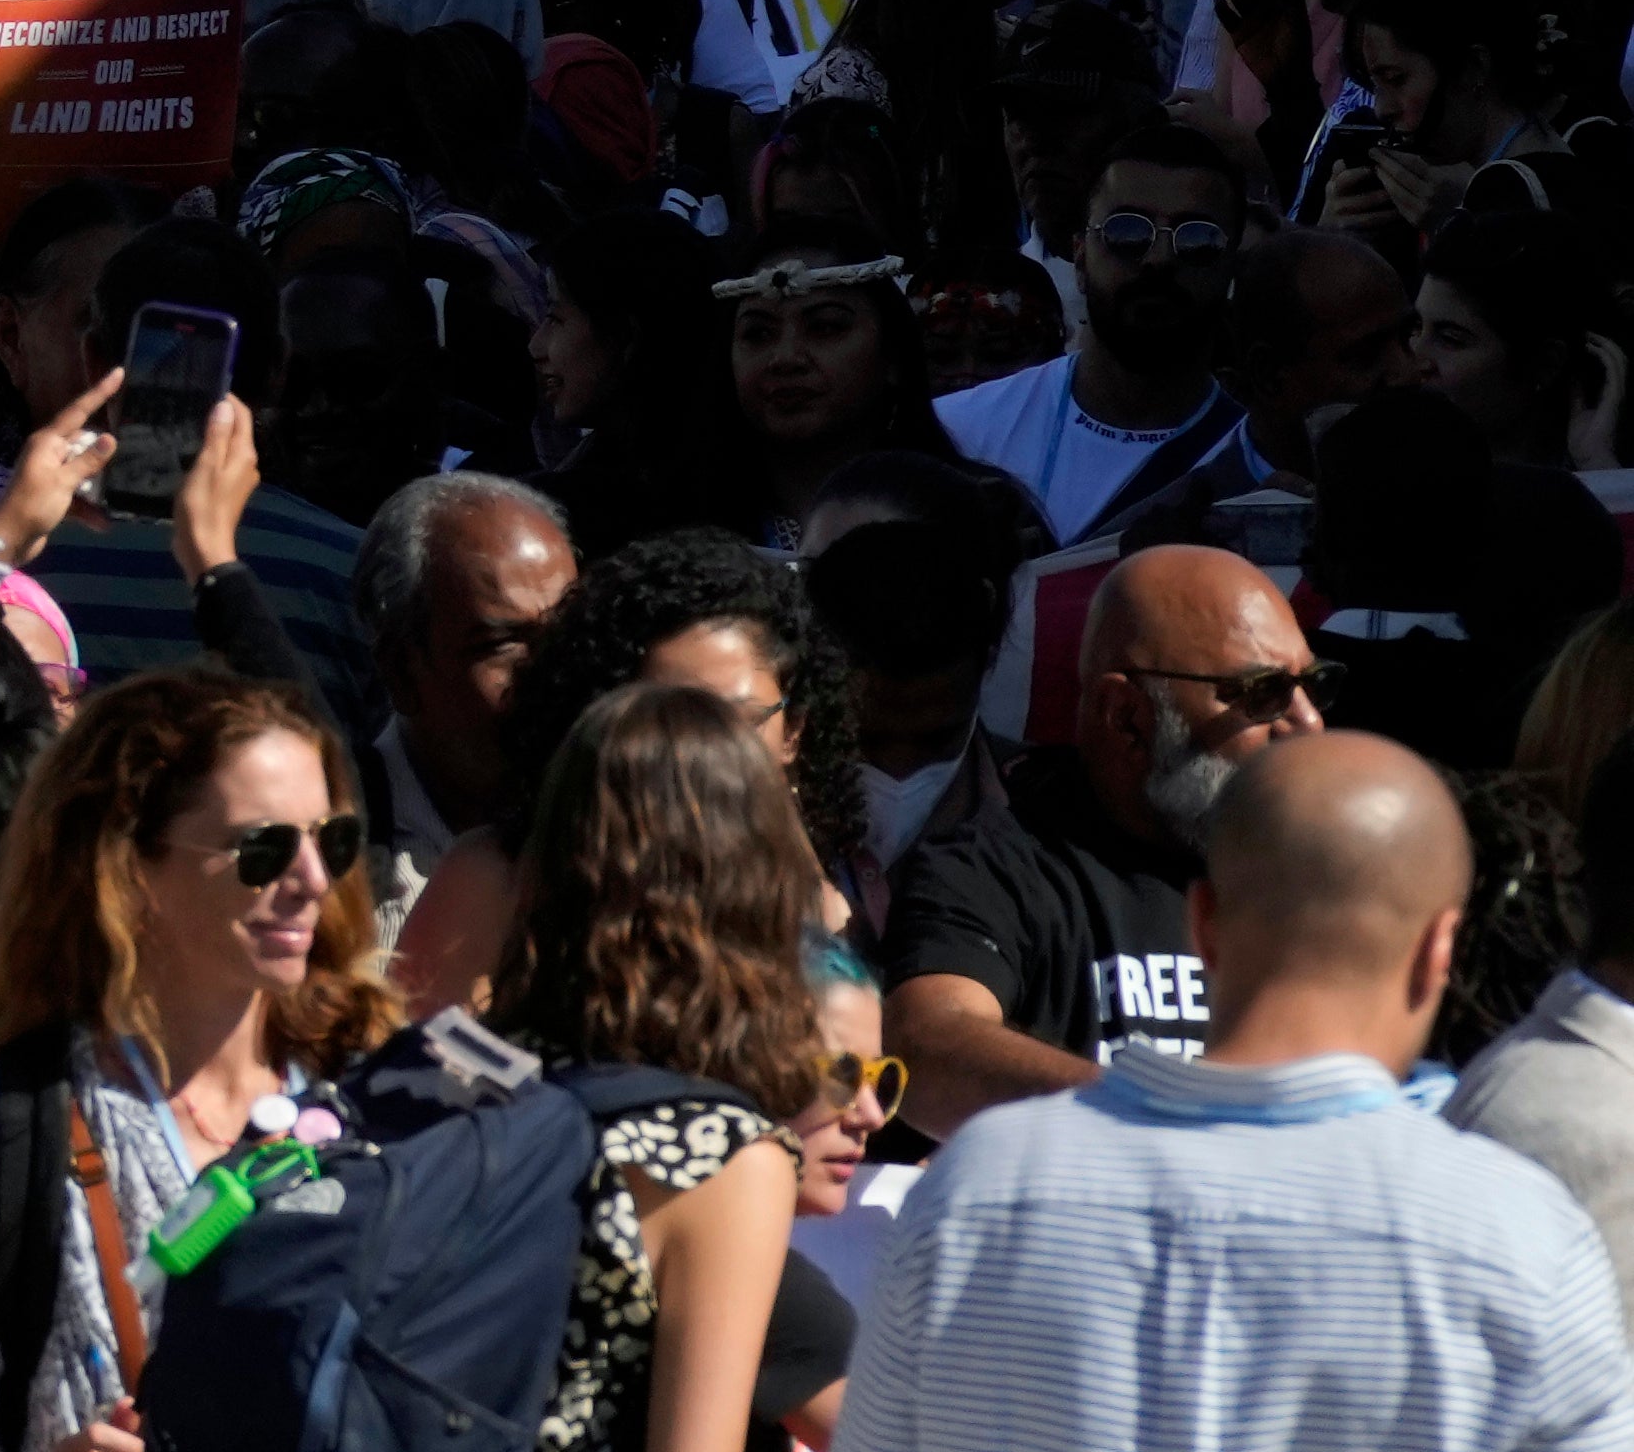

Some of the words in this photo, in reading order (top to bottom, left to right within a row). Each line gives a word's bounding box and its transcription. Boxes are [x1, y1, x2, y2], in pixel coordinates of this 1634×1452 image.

[110, 15, 150, 45] AND
[155, 9, 232, 41] RESPECT
[94, 58, 135, 85] OUR
[10, 100, 92, 134] LAND
[97, 96, 195, 133] RIGHTS
[1091, 952, 1211, 1024] FREE
